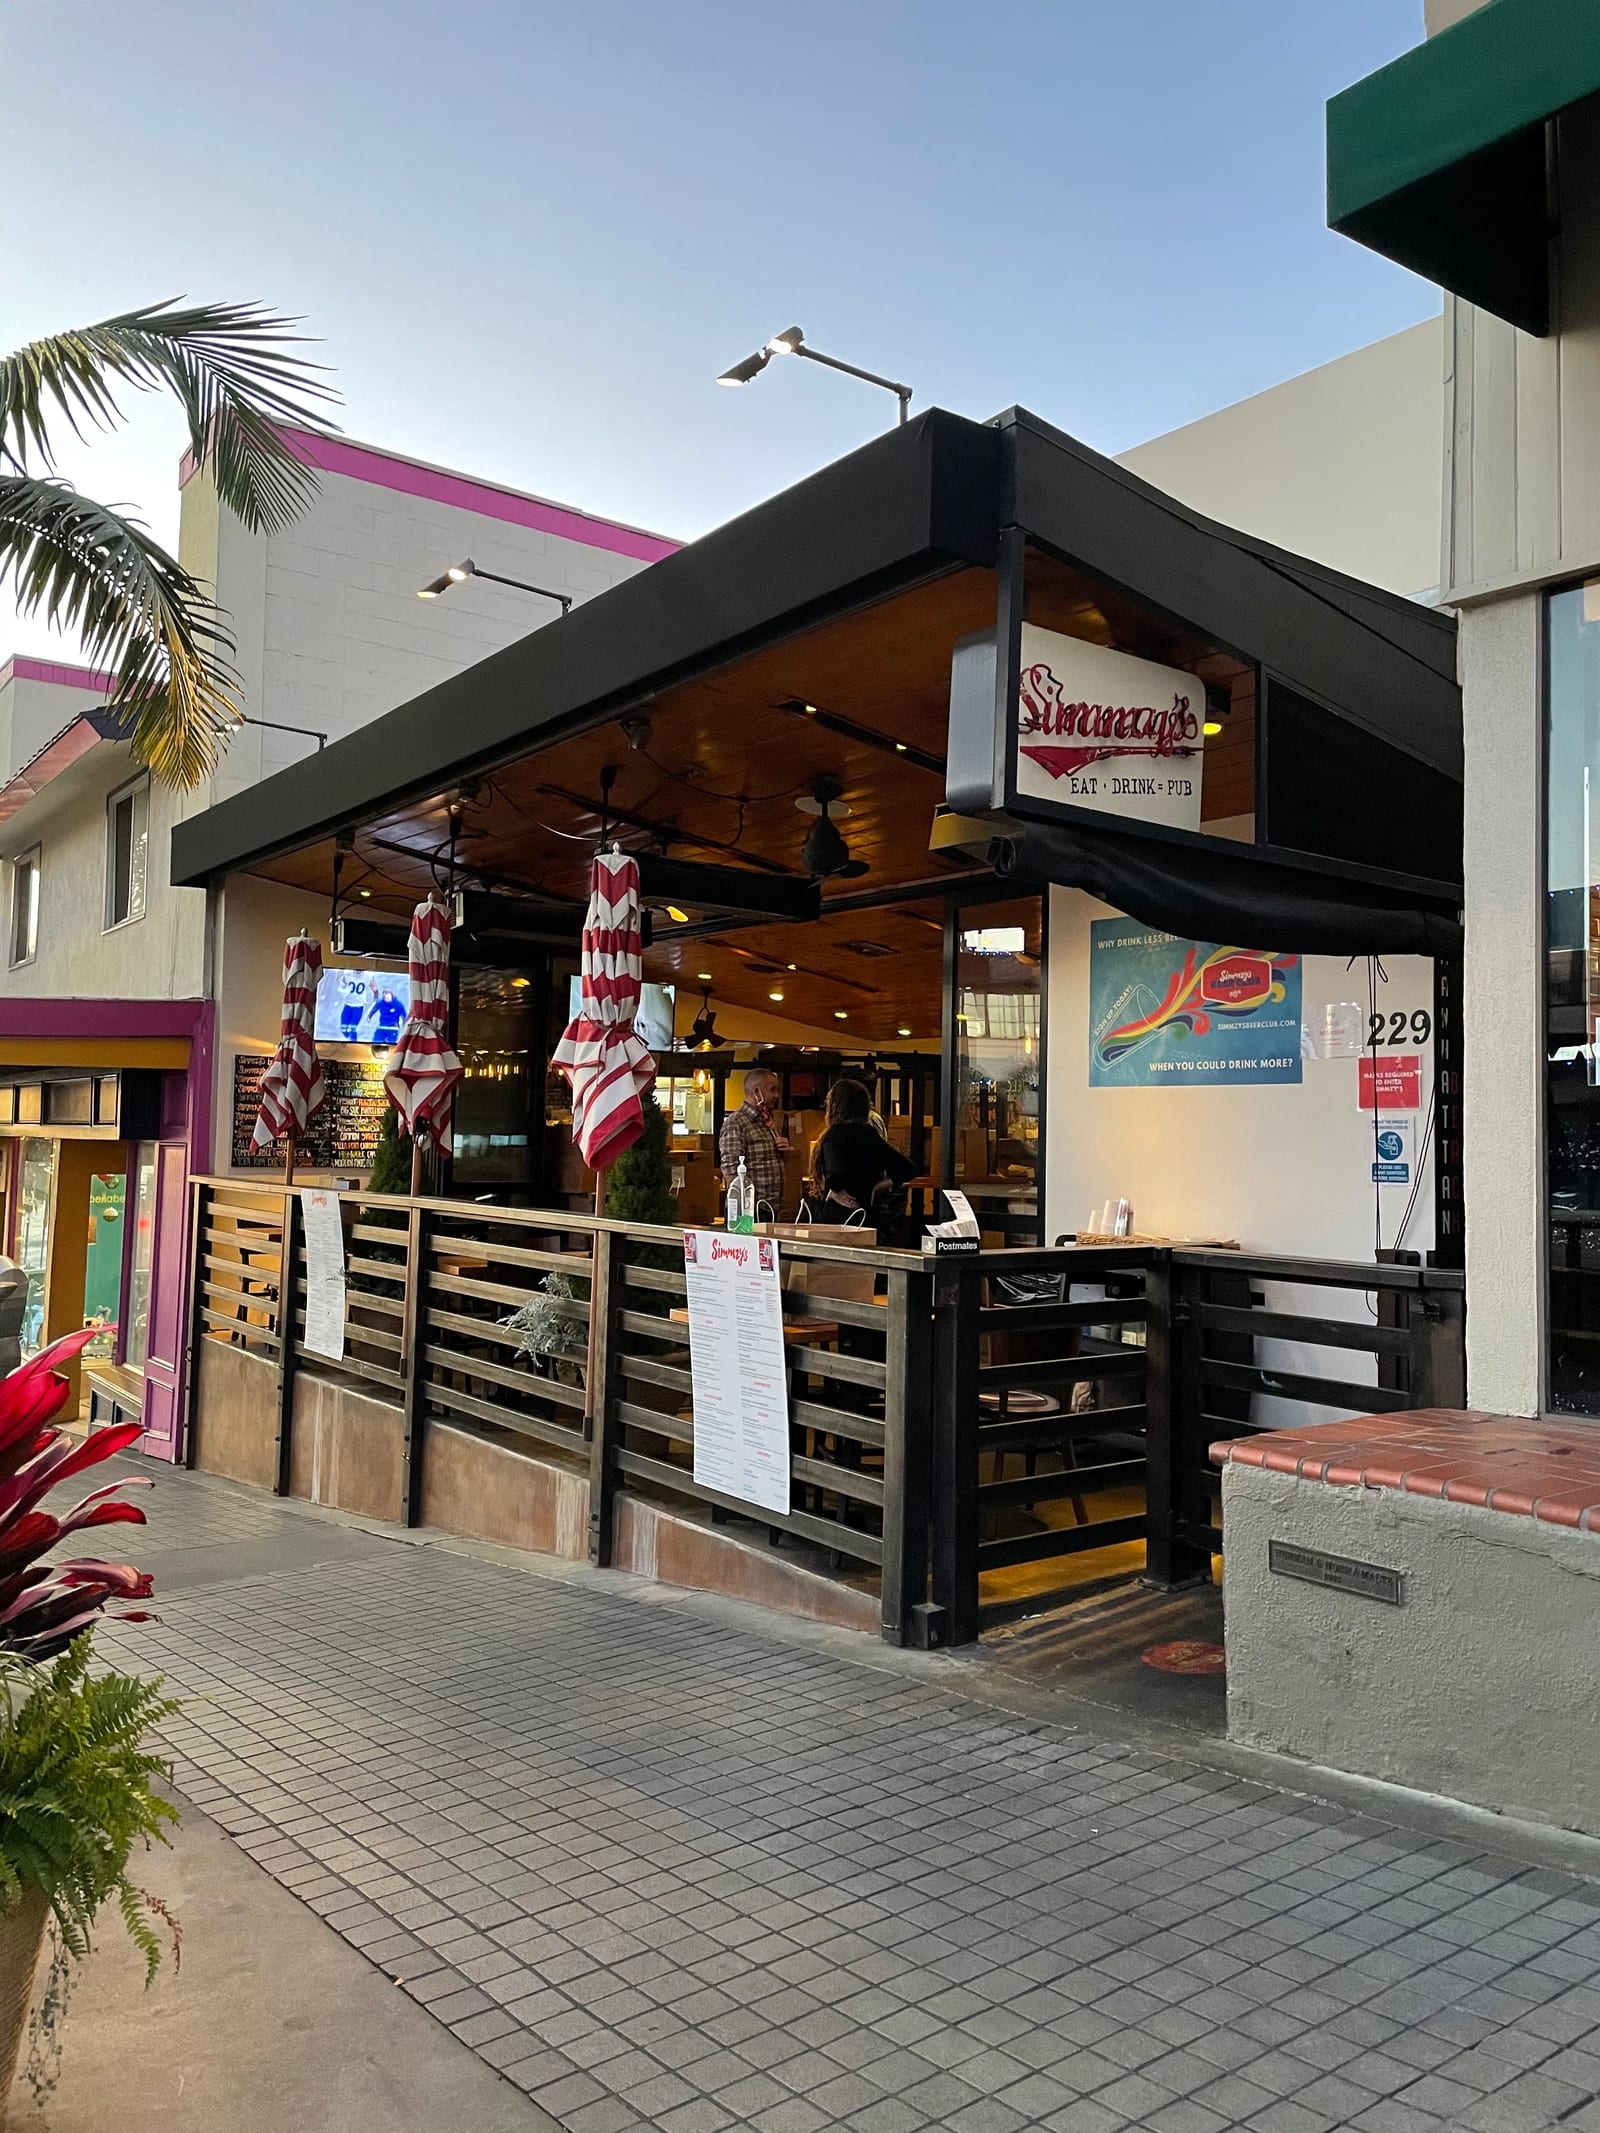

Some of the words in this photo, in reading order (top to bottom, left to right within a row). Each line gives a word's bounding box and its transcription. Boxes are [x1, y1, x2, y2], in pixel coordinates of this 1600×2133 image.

[1070, 777, 1098, 795] EAT
[1111, 777, 1156, 795] DRINK
[1167, 779, 1193, 796] PUB
[1097, 939, 1115, 949] WHY
[1117, 936, 1142, 948] DRINK
[1143, 934, 1163, 945] LESS
[1105, 1008, 1114, 1021] UP
[1366, 1009, 1432, 1046] 229
[1149, 1062, 1175, 1072] WHEN
[1175, 1061, 1195, 1071] YOU
[1196, 1060, 1226, 1070] COULD
[1228, 1059, 1258, 1069] DRINK
[1260, 1058, 1294, 1068] MORE?
[711, 1238, 749, 1267] Simmzy's
[938, 1241, 978, 1251] Postmates
